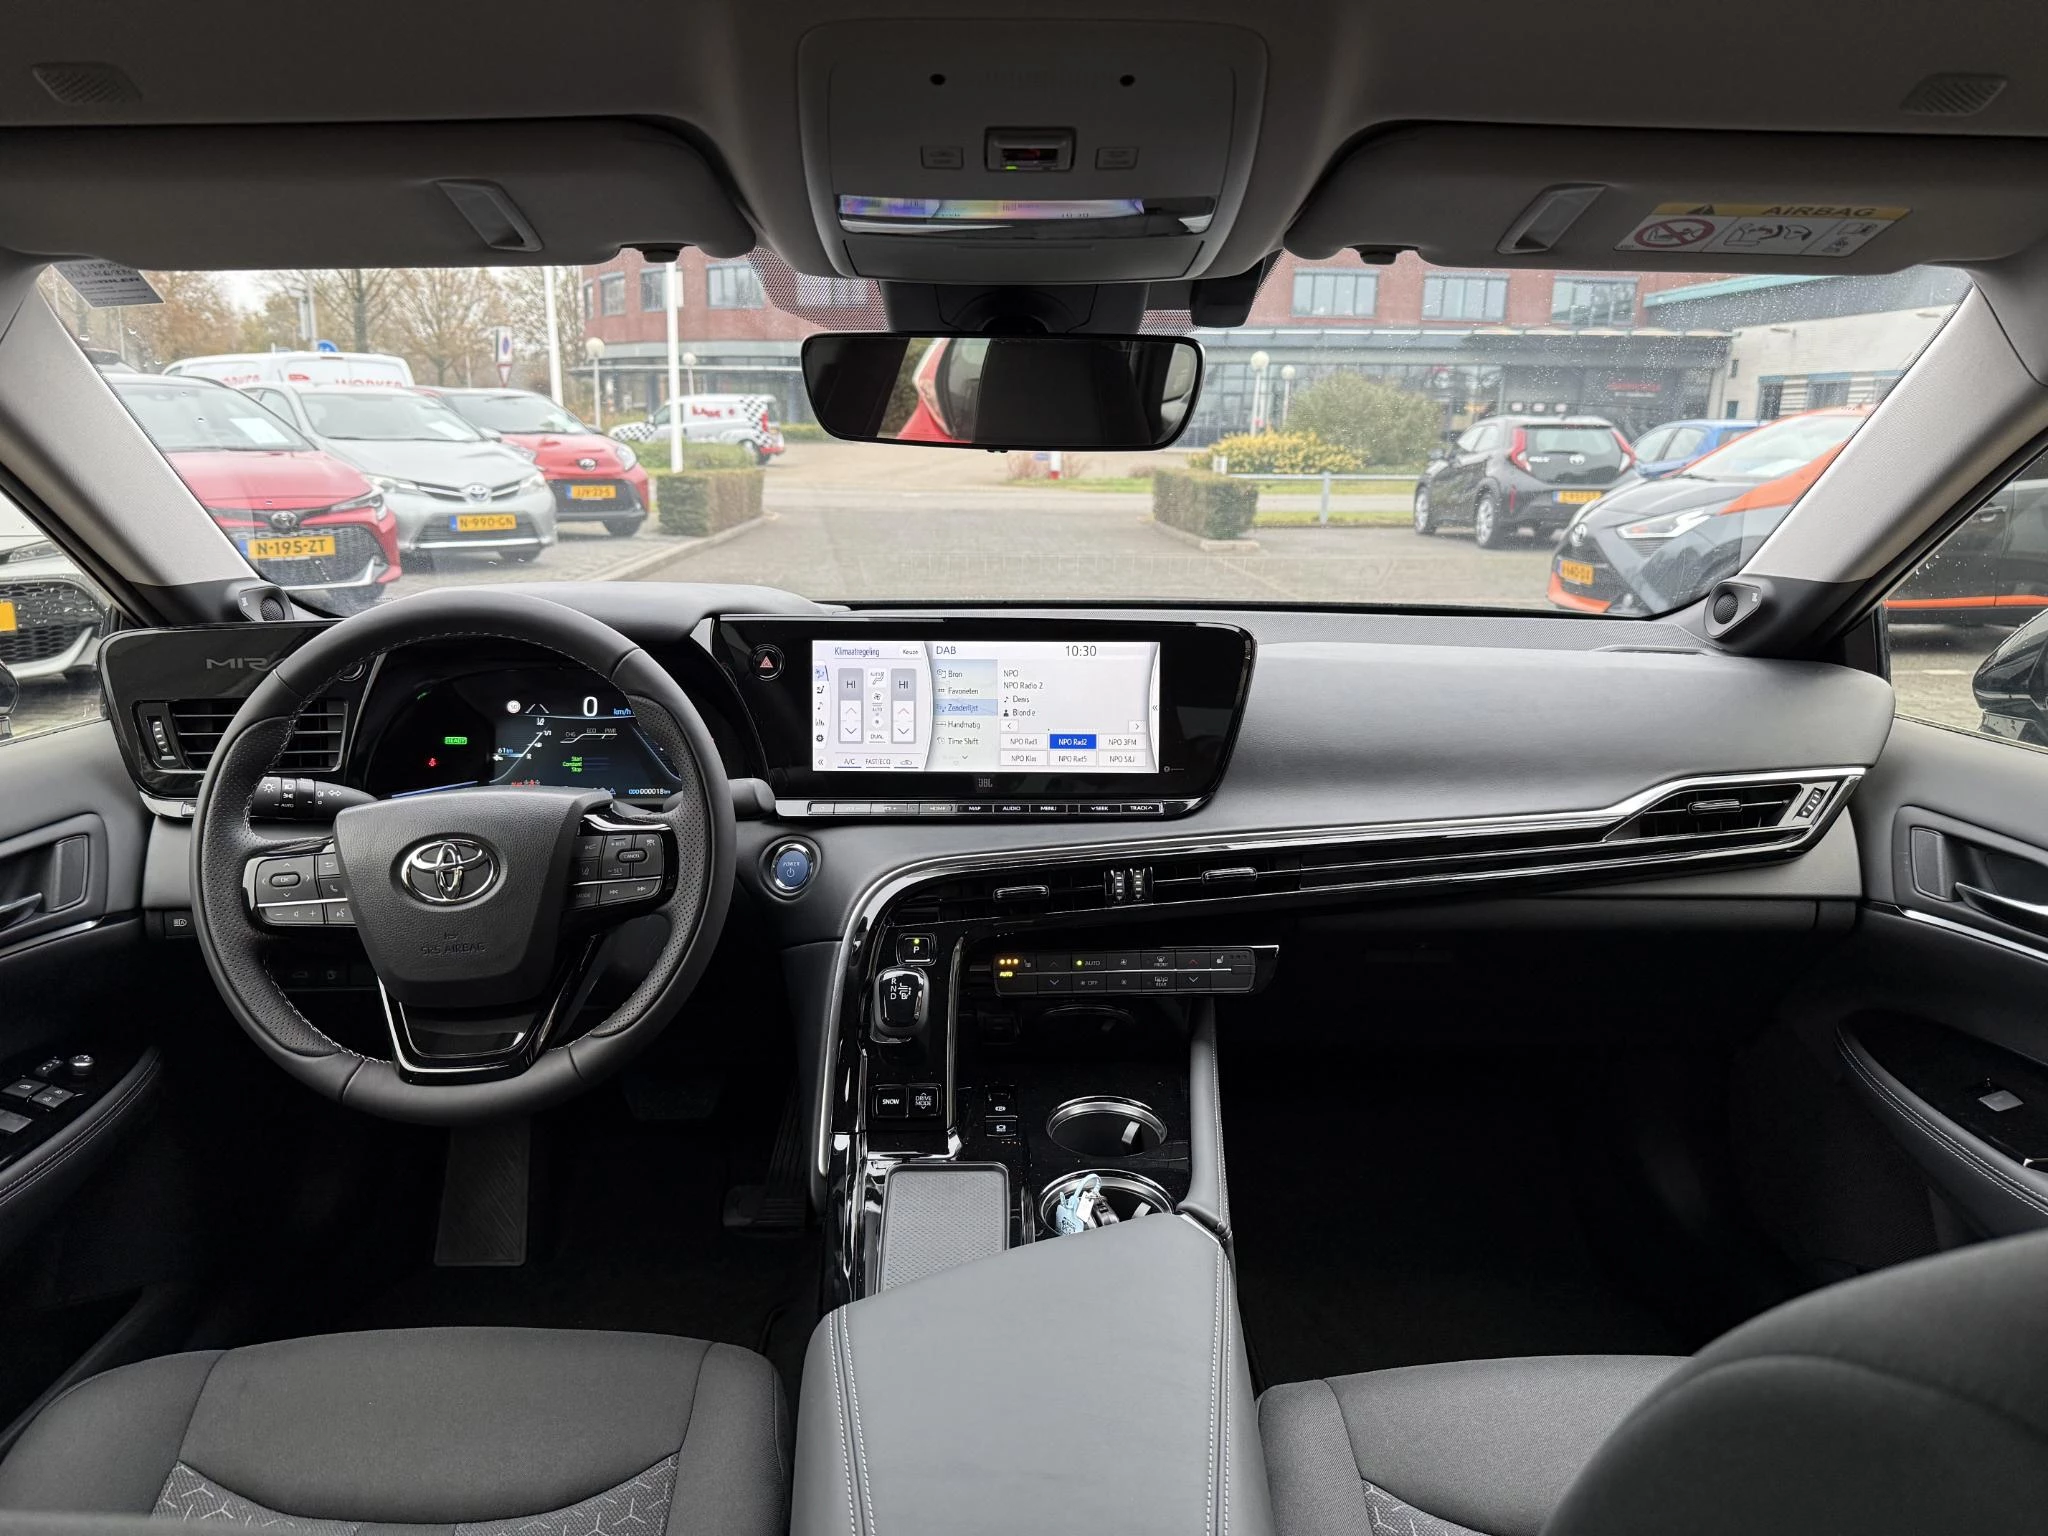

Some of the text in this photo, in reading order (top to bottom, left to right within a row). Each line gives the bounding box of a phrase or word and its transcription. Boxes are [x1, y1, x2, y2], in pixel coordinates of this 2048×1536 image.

[1762, 206, 1879, 217] AIRBAG
[257, 539, 326, 555] N-195-ZT
[834, 647, 880, 657] Klimaatregeling
[936, 645, 957, 655] DAB
[1065, 645, 1097, 657] 10:30
[206, 657, 286, 672] MIR
[1003, 669, 1019, 677] NPO
[846, 680, 856, 689] HI
[898, 680, 909, 689] HI
[582, 696, 598, 717] 0
[613, 707, 633, 715] km/h
[948, 737, 979, 745] Time Shift
[1058, 738, 1088, 746] NPO Rad2
[1108, 738, 1123, 746] NPO
[913, 946, 920, 954] P
